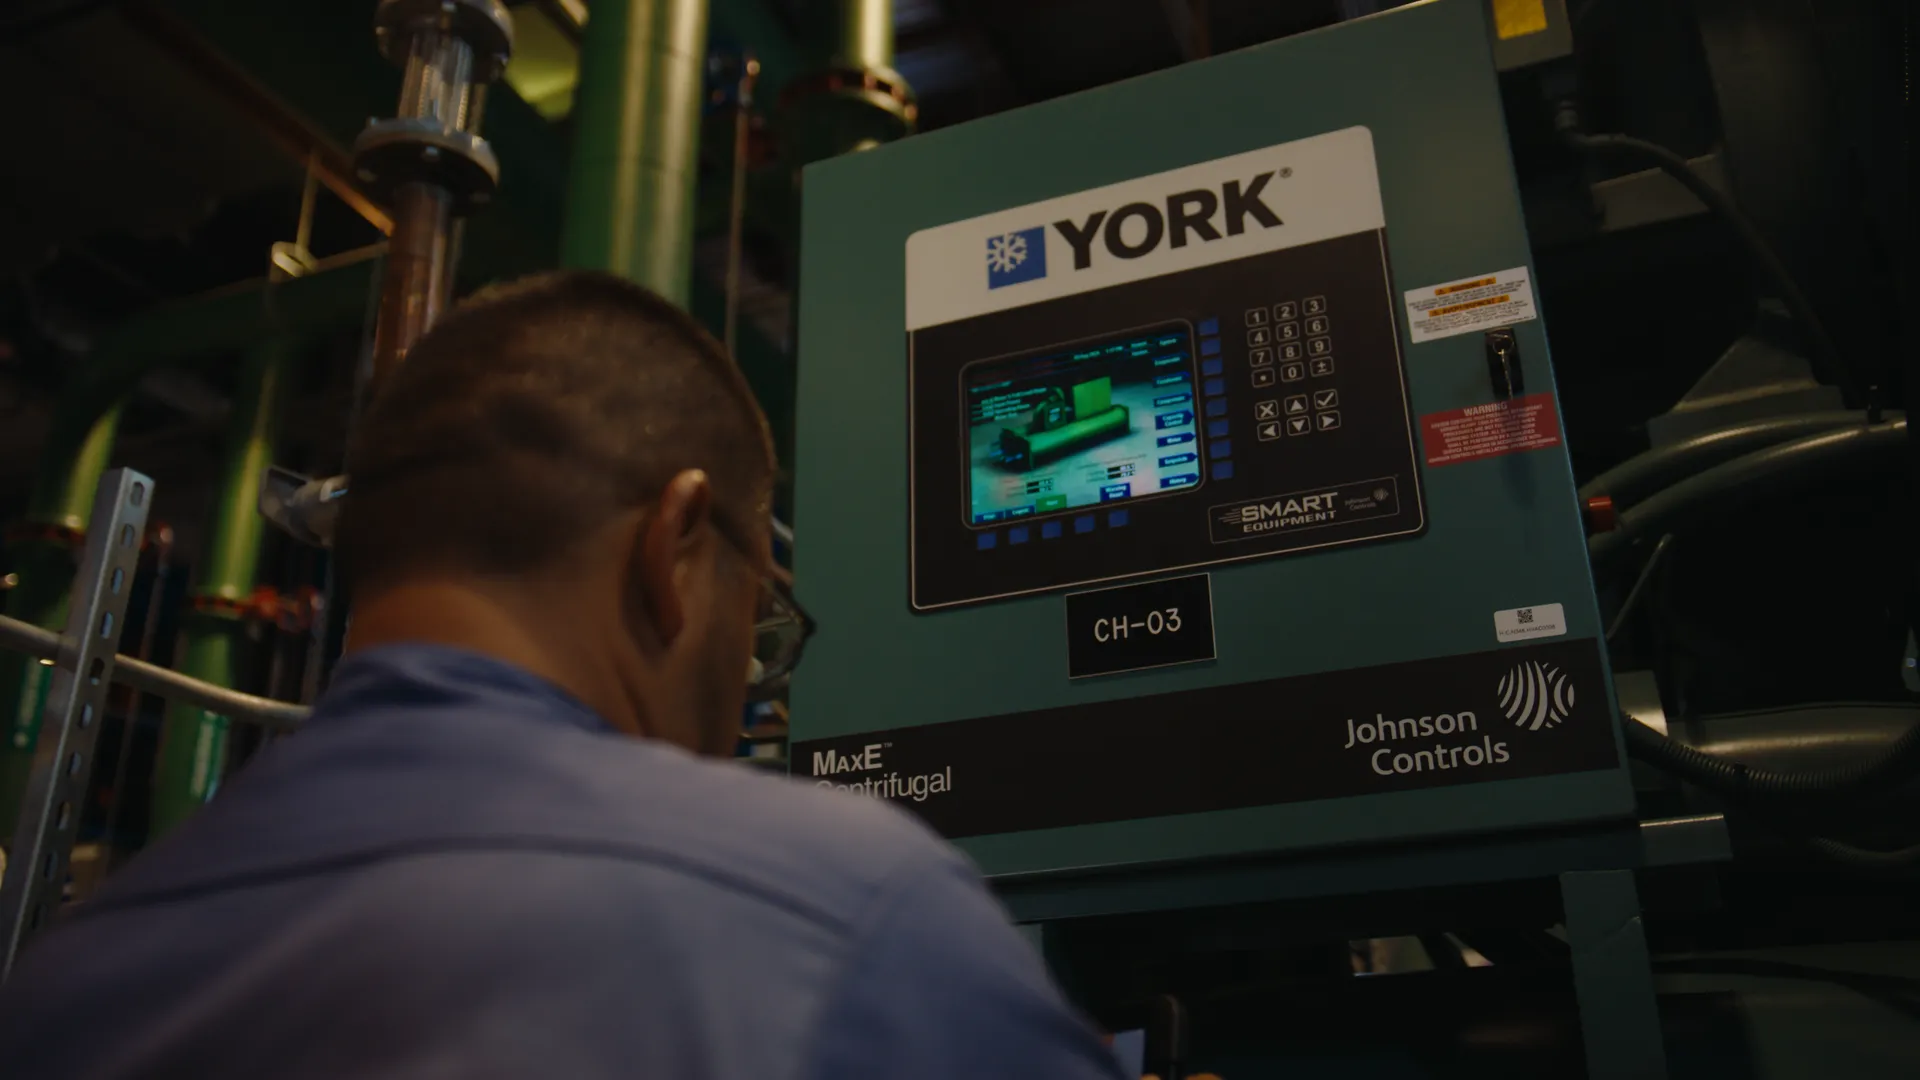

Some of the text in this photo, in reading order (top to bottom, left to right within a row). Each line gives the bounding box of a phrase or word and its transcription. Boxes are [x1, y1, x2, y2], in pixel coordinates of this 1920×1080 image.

[1253, 300, 1319, 323] 1 2 3
[1254, 320, 1321, 342] 4 5 6
[1256, 341, 1324, 363] 7 8 9
[1288, 367, 1297, 378] 0
[1464, 401, 1508, 416] WARNING
[1241, 492, 1338, 522] SMART
[1243, 510, 1337, 533] EQUIPMENT
[1094, 607, 1182, 642] CH-03
[1344, 711, 1478, 749] Johnson
[1371, 735, 1510, 776] Controls
